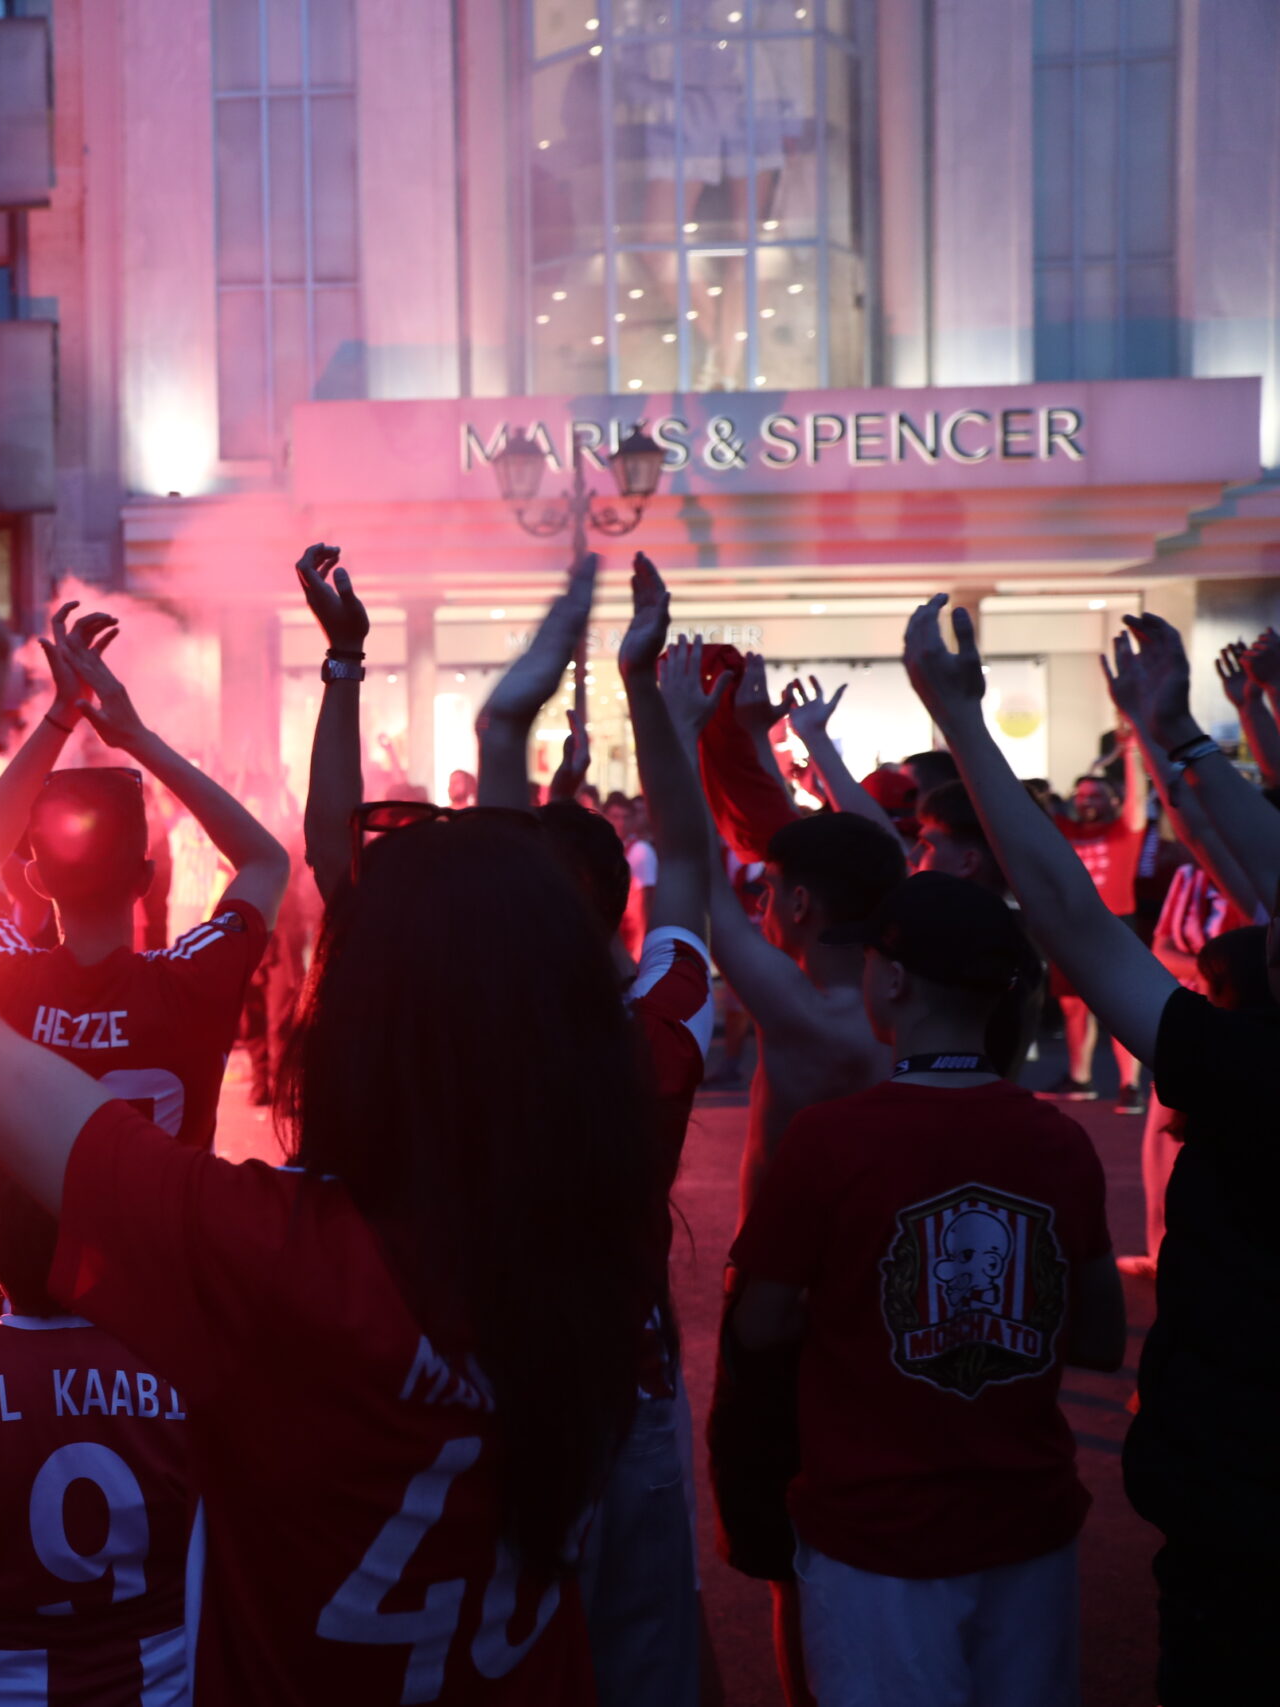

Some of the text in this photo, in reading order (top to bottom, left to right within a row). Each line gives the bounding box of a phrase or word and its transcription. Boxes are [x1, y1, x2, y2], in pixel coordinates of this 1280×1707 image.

[703, 417, 749, 470] &
[759, 407, 1086, 470] SPENCER
[31, 1004, 130, 1050] HEZZE
[29, 1441, 150, 1616] 9
